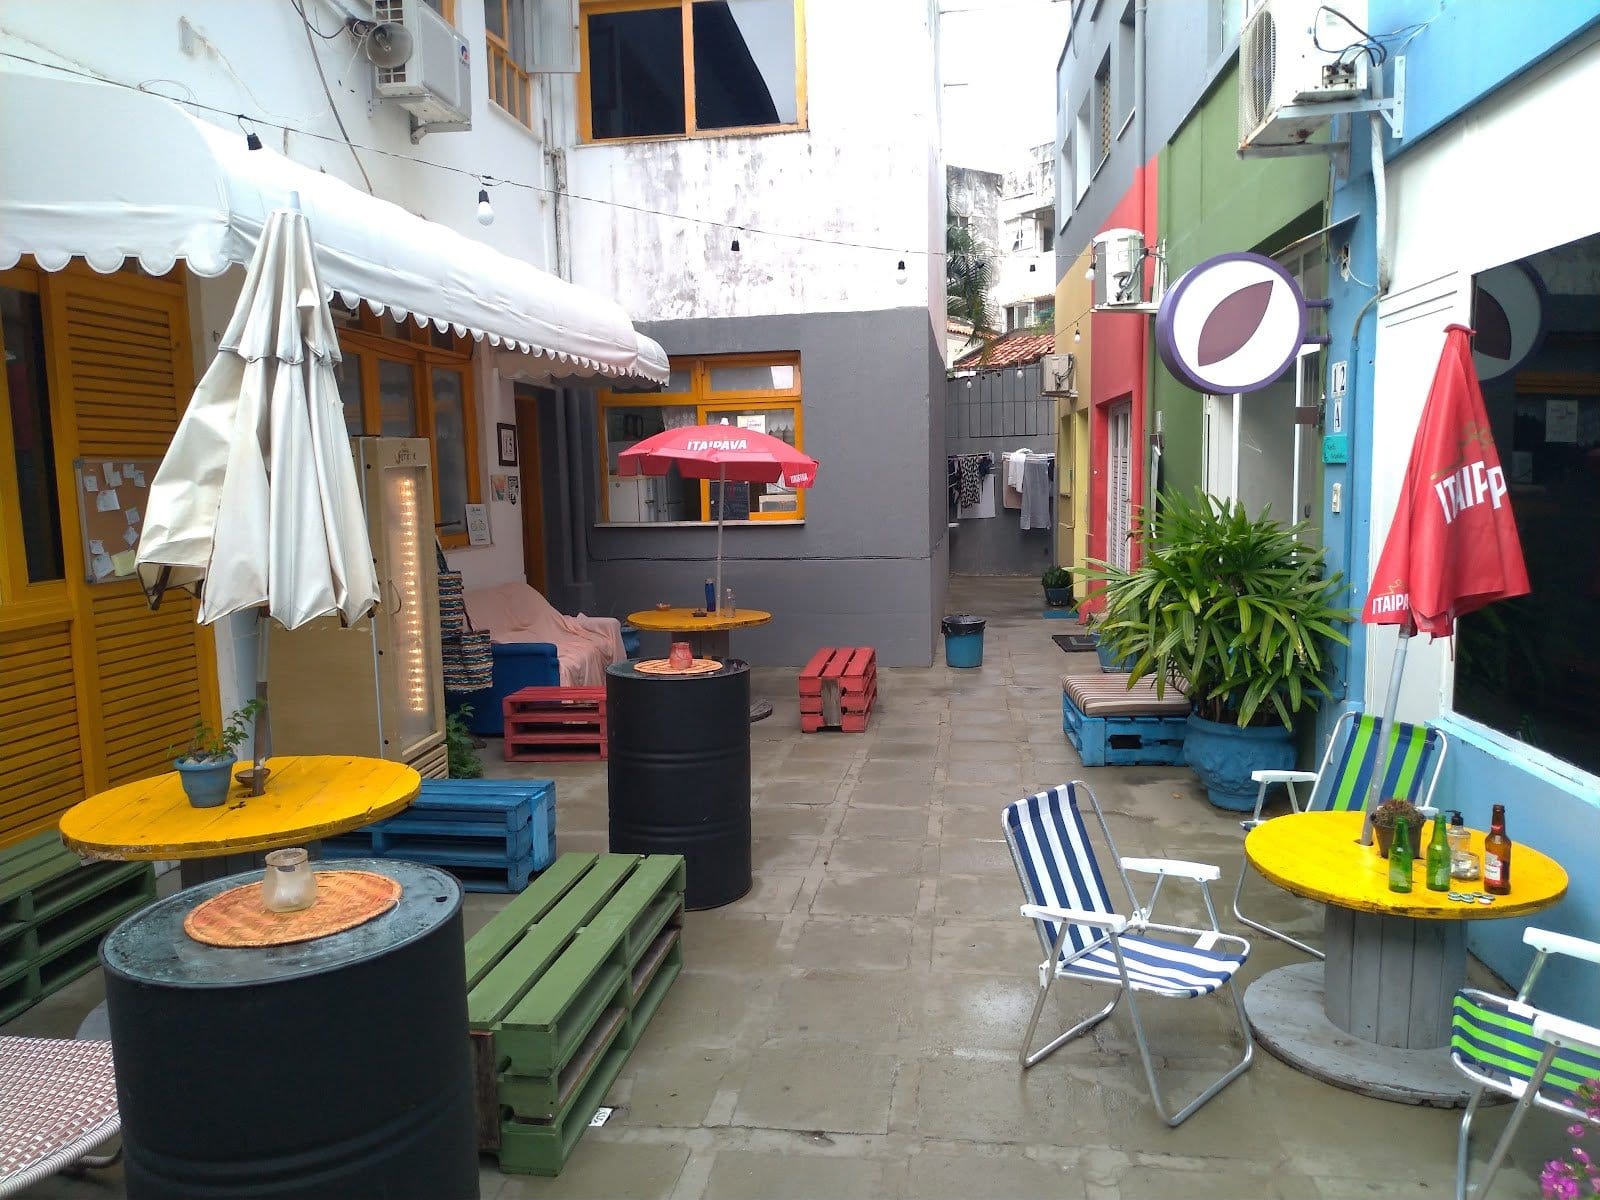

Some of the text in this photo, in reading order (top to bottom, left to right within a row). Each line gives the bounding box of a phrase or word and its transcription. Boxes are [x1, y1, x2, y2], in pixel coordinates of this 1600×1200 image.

[1332, 366, 1345, 392] 12
[687, 439, 748, 451] ITAIPAVA
[1372, 593, 1409, 615] ITAIPA
